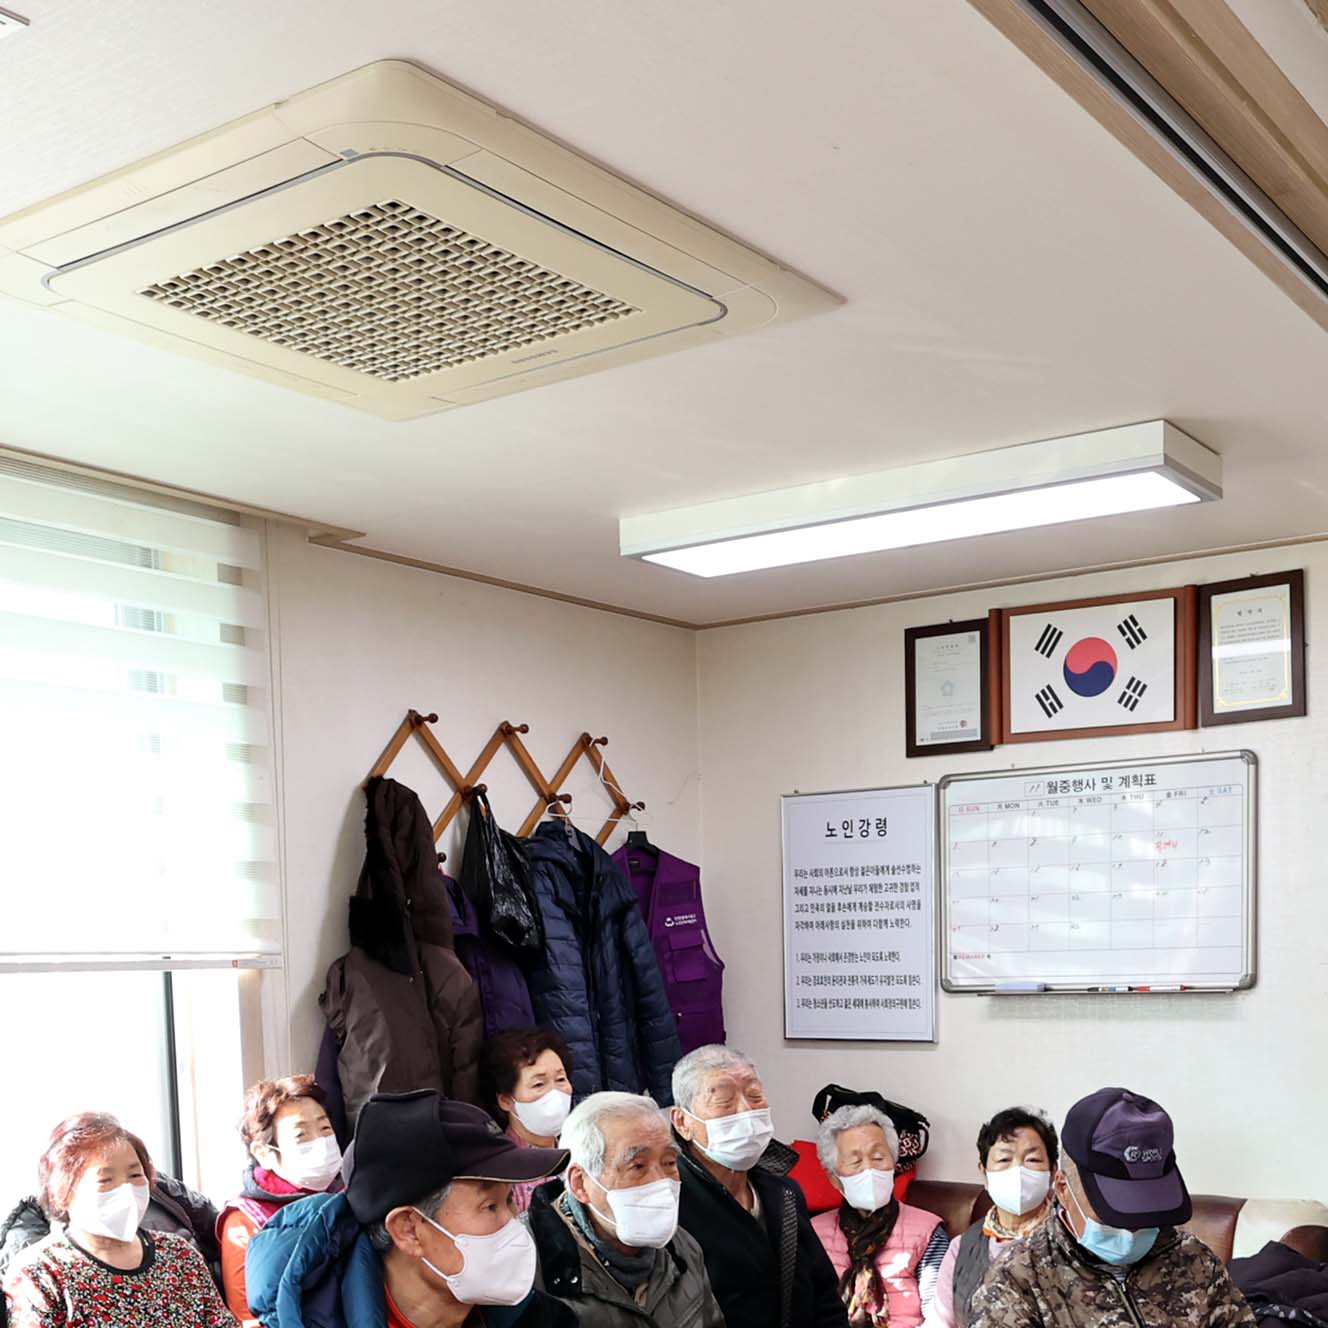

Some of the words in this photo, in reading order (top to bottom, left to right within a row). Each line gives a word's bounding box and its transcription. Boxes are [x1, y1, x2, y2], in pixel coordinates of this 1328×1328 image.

[1046, 777, 1096, 794] 월중행사
[1101, 776, 1114, 790] 및
[1118, 773, 1157, 788] 계획표
